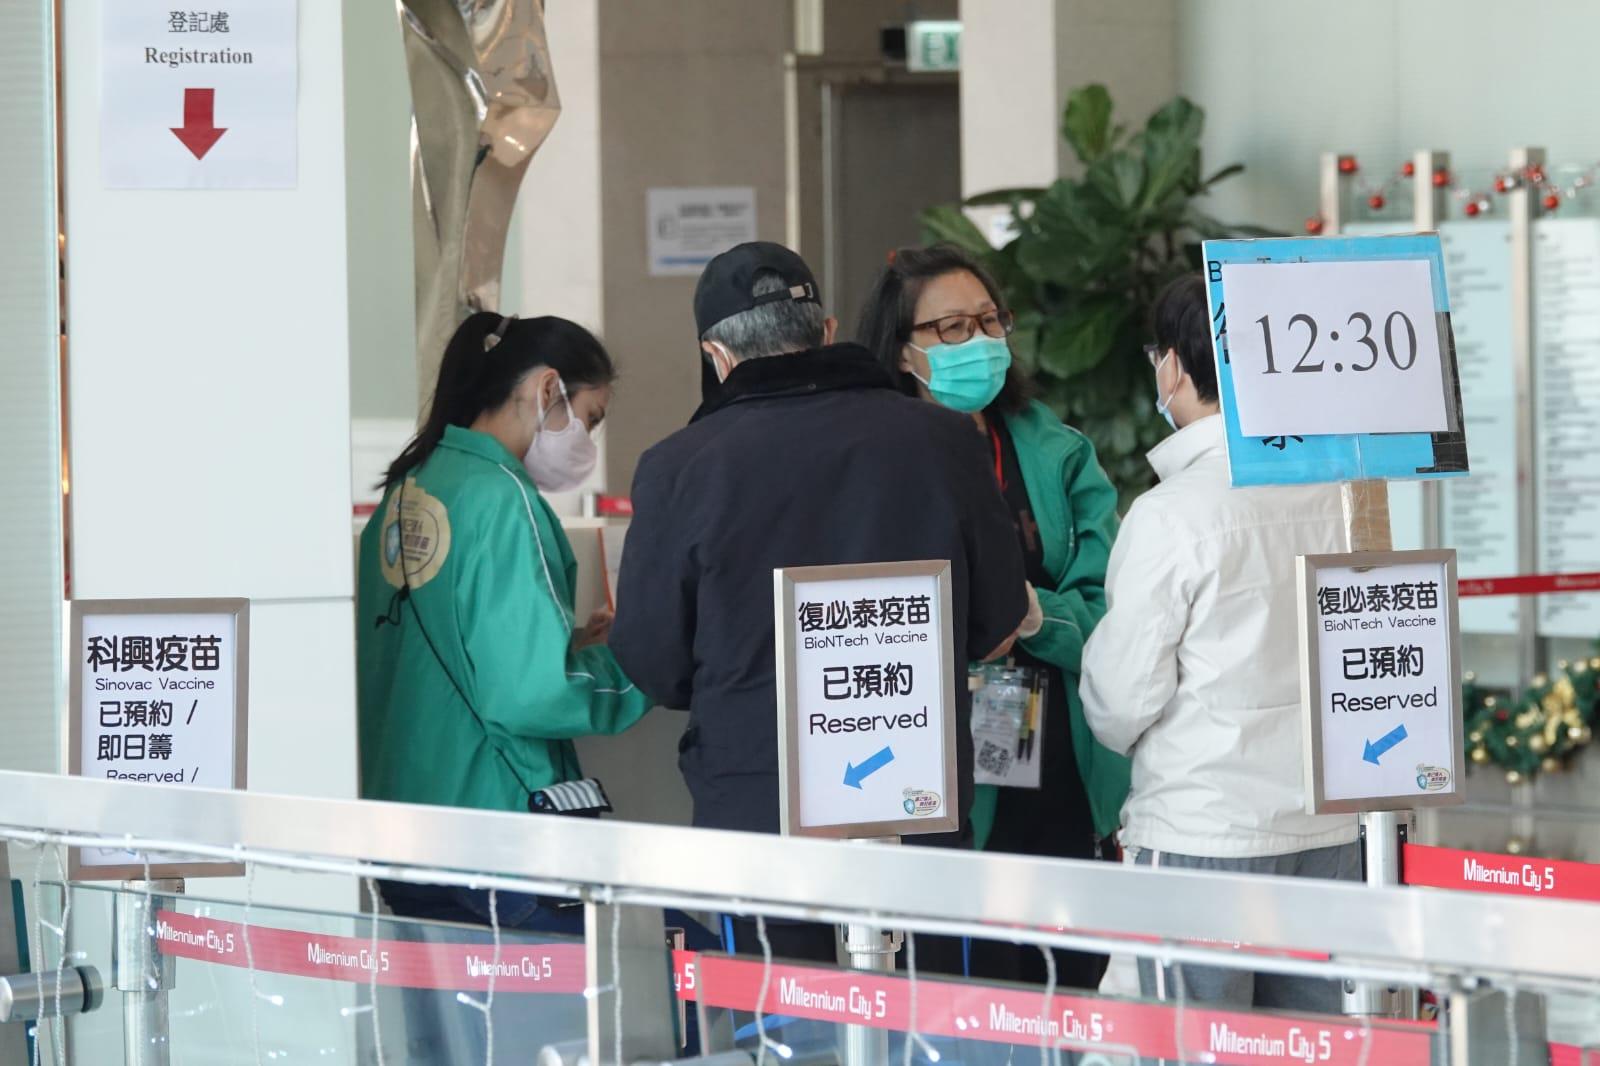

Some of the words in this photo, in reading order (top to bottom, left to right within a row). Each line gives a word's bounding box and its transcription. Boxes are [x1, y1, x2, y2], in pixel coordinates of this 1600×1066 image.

[167, 10, 230, 34] 登記處
[144, 47, 254, 69] Registration
[1255, 310, 1417, 375] 12:30
[798, 594, 931, 633] 復必泰疫苗
[1316, 580, 1439, 616] 復必泰疫苗
[1324, 618, 1383, 632] BioNTech
[1387, 615, 1437, 628] Vaccine
[86, 634, 222, 673] 科興疫苗
[804, 633, 869, 650] BioNTech
[874, 630, 928, 645] Vaccine
[1342, 644, 1424, 681] 已預約
[95, 677, 152, 691] Sinovac
[158, 676, 215, 690] Vaccine
[822, 661, 914, 701] 已預約
[99, 699, 173, 728] 已預約
[1331, 685, 1438, 714] Reserved
[809, 705, 928, 736] Reserved
[96, 733, 173, 762] 即日籌
[106, 768, 184, 783] Reserved
[1463, 858, 1520, 885] Millennium
[1522, 864, 1542, 892] City
[1544, 866, 1554, 890] 5
[156, 919, 205, 946] Millennium
[206, 929, 225, 954] City
[226, 933, 235, 952] 5
[307, 942, 358, 968] Millennium
[360, 949, 379, 973] City
[380, 951, 389, 971] 5
[521, 956, 541, 981] City
[542, 956, 552, 978] 5
[685, 963, 696, 990] 5
[780, 976, 846, 1013] Millennium
[849, 986, 872, 1020] City
[875, 990, 887, 1018] 5
[989, 1002, 1059, 1036] Millennium
[1062, 1009, 1088, 1041] City
[1090, 1012, 1104, 1042] 5
[1210, 1022, 1285, 1057] Millennium
[1288, 1027, 1316, 1063] City
[1318, 1030, 1332, 1060] 5
